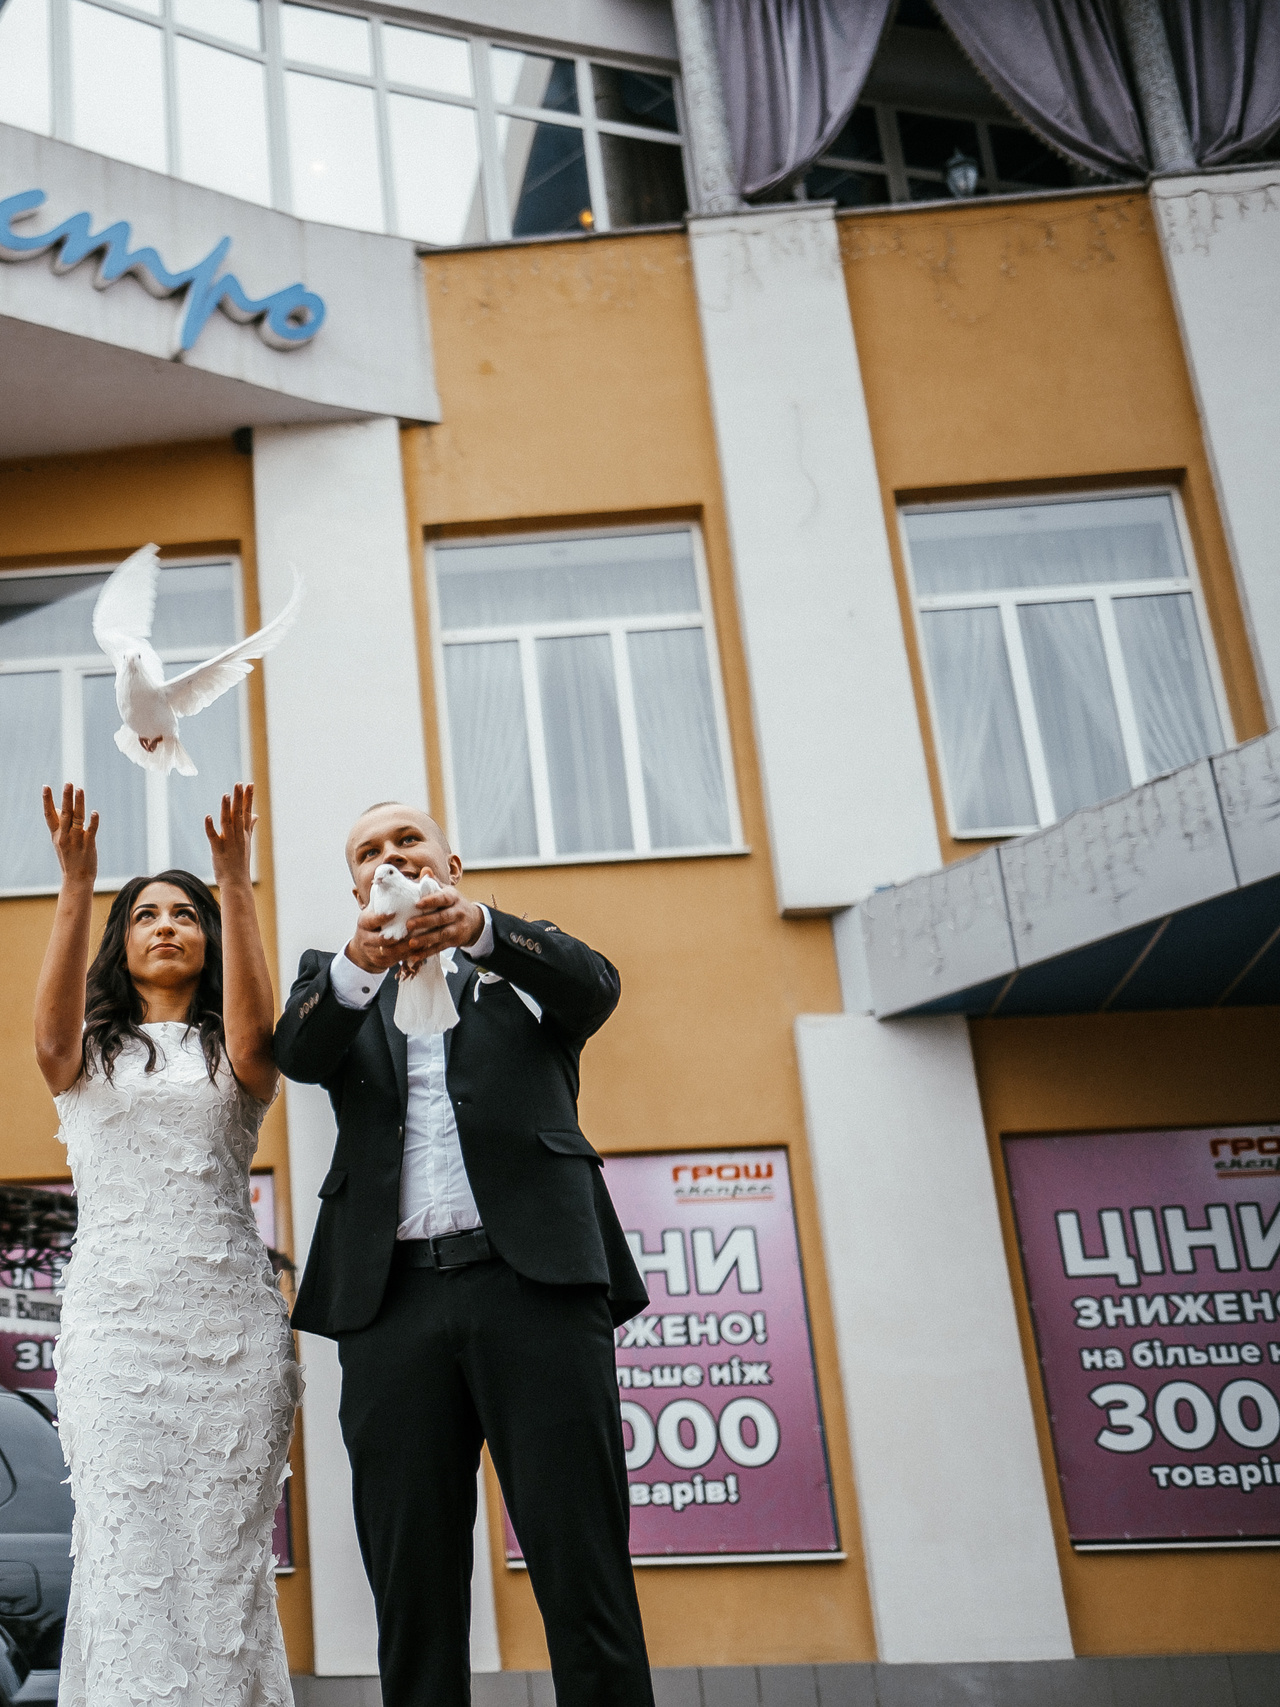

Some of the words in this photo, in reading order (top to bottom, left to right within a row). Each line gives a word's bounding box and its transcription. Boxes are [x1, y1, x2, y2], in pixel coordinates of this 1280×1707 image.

[672, 1163, 773, 1182] ГРОШ
[1215, 1158, 1280, 1171] експ
[1072, 1290, 1280, 1329] ЗНИЖЕН
[615, 1311, 767, 1348] ЖЕНО!
[1080, 1346, 1125, 1370] на
[1130, 1339, 1262, 1369] більше
[708, 1355, 773, 1387] ніж
